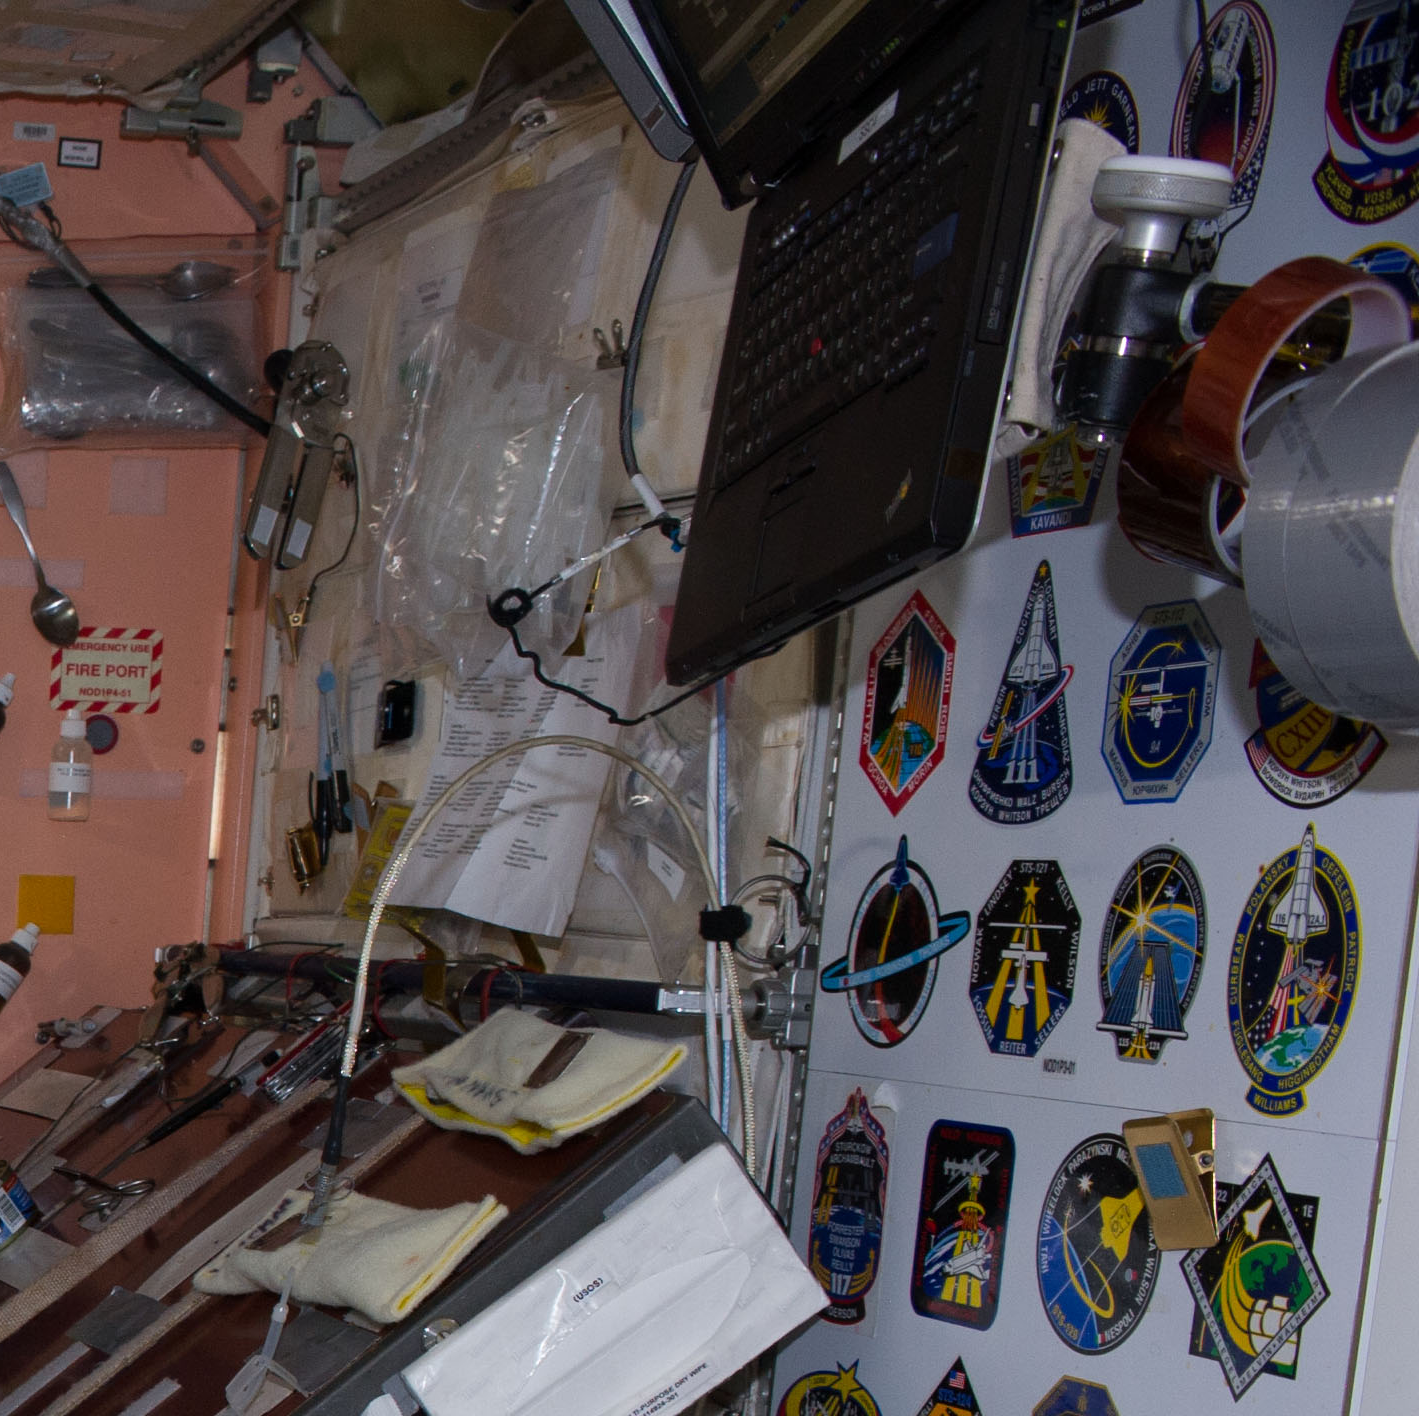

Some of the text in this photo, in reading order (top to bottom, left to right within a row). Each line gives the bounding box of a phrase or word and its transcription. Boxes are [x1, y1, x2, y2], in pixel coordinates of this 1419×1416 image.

[1084, 78, 1136, 147] JETT GARNEAU
[1365, 188, 1392, 204] VOSS
[1030, 511, 1072, 531] KAVANDI
[131, 644, 150, 653] USE
[1121, 626, 1142, 662] ASHBY
[66, 663, 147, 678] FIRE PORT
[863, 667, 876, 745] WALHEIM
[989, 685, 1008, 727] PERRIN
[1203, 682, 1213, 717] WOLF
[1002, 759, 1039, 784] 111
[1109, 748, 1128, 789] MAGNUS
[1175, 739, 1204, 786] SELLERS
[1291, 777, 1321, 788] WHITSON
[998, 810, 1031, 821] WHITSON
[1019, 863, 1049, 874] STS-121
[1247, 856, 1289, 915] POLANSKY
[983, 869, 1013, 916] LINDSEY
[1055, 876, 1074, 912] KELLY
[972, 927, 983, 983] NOWAK
[1066, 930, 1080, 989] WILSON
[1229, 934, 1245, 1005] CURBEAM
[1345, 932, 1357, 992] PATRICK
[973, 995, 995, 1043] FOSSUM
[1034, 1002, 1066, 1049] SELLERS
[999, 1042, 1027, 1054] REITER
[1233, 1020, 1264, 1083] FUGLESANG
[1278, 1023, 1340, 1089] HIGGINBOTHAM
[1253, 1093, 1297, 1111] WILLIAMS
[1042, 1143, 1114, 1235] WHEELOCK PARAZYNSKI
[1302, 1204, 1314, 1218] 1E
[1267, 1174, 1320, 1289] POINDEXTER
[831, 1258, 854, 1273] REILLY
[1040, 1246, 1050, 1274] TANI
[573, 1277, 604, 1303] (USOS)
[830, 1272, 851, 1296] 117
[1134, 1257, 1156, 1306] WILSON
[1104, 1309, 1135, 1342] NESPOLI
[1276, 1296, 1318, 1345] WALHEIM
[1205, 1312, 1239, 1382] SCHLEGEL
[675, 1375, 689, 1389] DRY
[689, 1363, 707, 1378] WIPE
[1239, 1349, 1273, 1386] MELVIN
